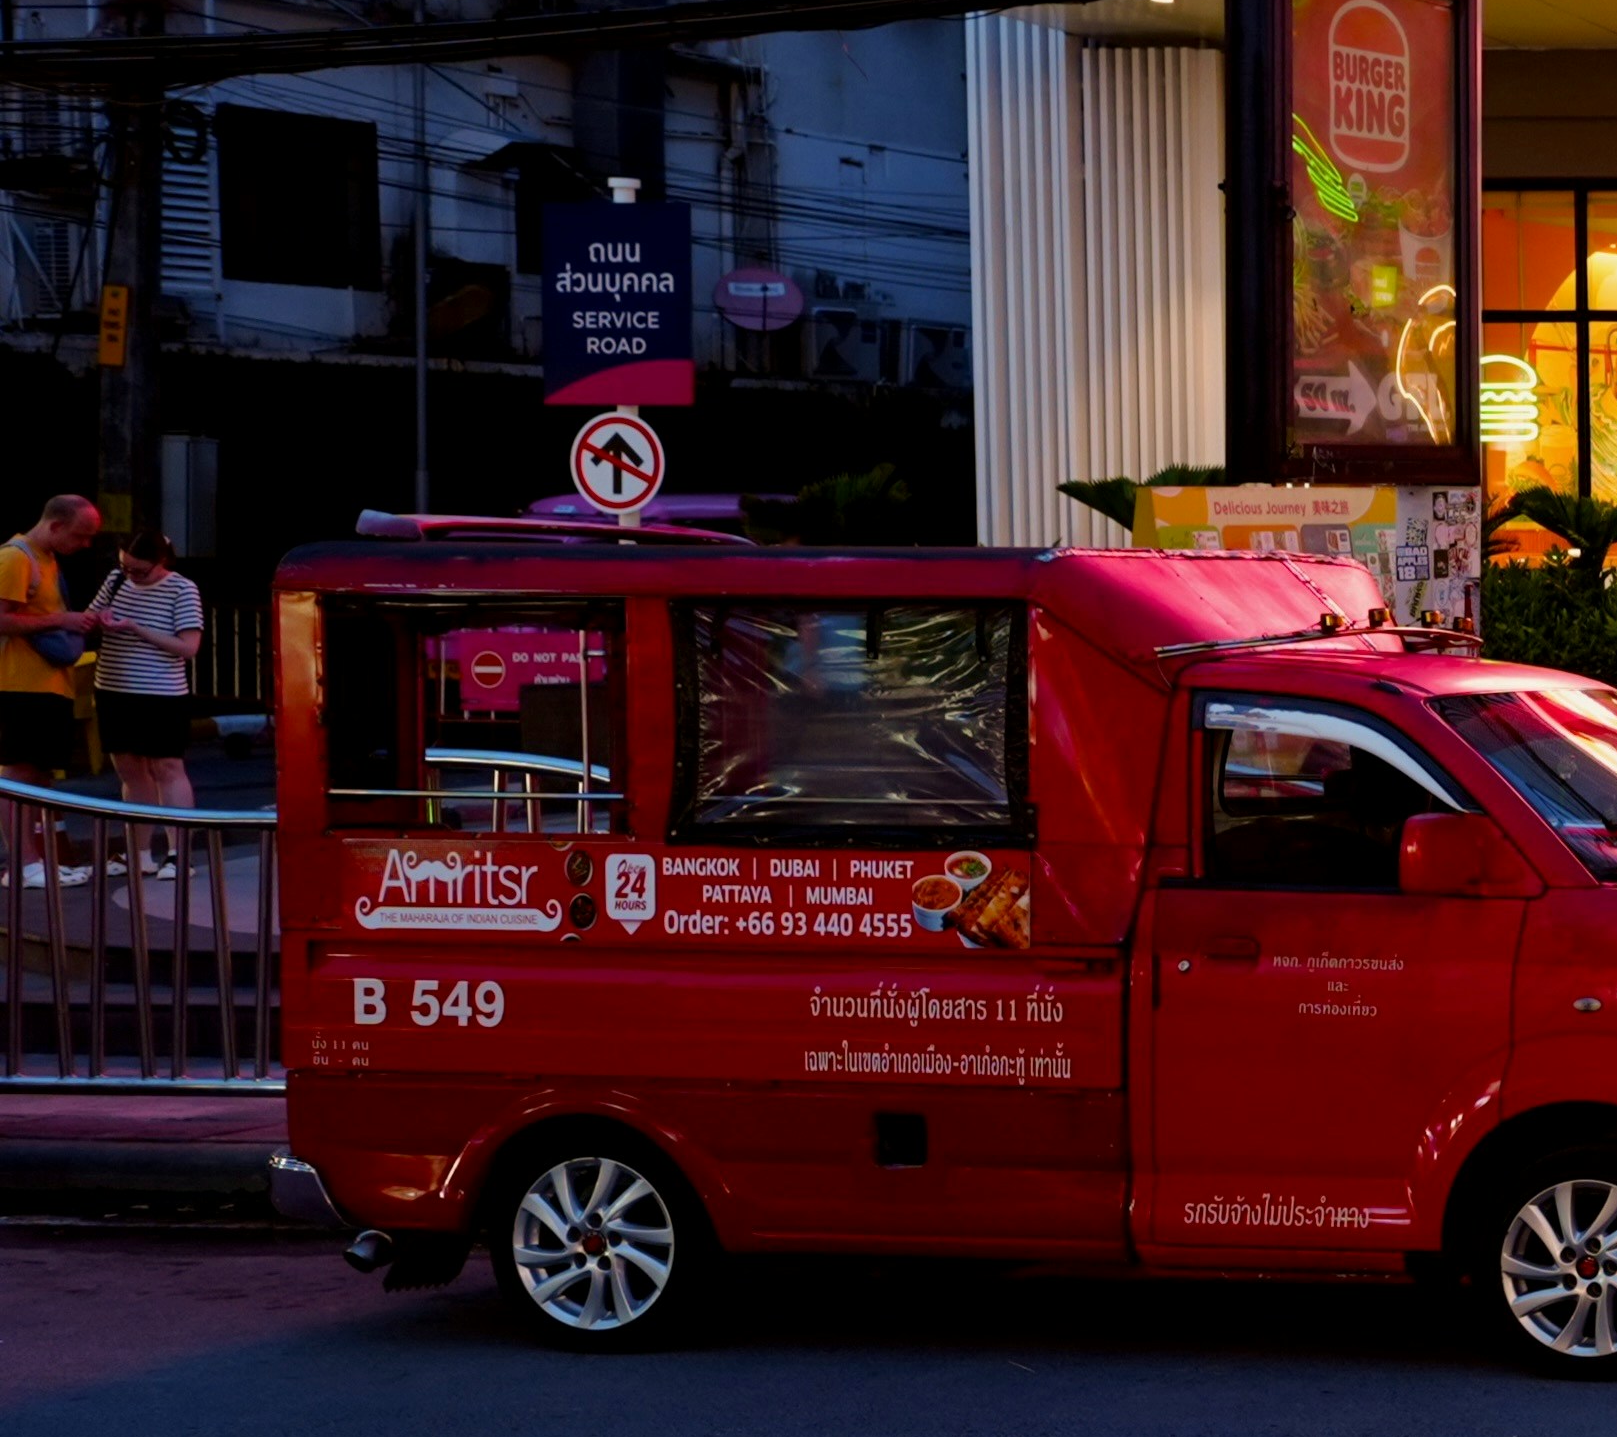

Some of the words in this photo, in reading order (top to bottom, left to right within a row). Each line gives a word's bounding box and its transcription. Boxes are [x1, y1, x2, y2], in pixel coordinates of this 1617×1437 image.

[1332, 50, 1406, 93] BURGER
[1333, 83, 1407, 138] KING
[588, 242, 641, 263] ถนน
[556, 262, 674, 302] ส่วนบุคคล
[572, 311, 660, 329] SERVICE
[586, 337, 647, 354] ROAD
[1213, 501, 1262, 516] Delicious
[1265, 501, 1306, 517] Journey
[1311, 499, 1349, 516] 美味之旅
[512, 651, 530, 663] DO
[533, 651, 558, 663] NOT
[378, 849, 539, 906] Amritsr
[662, 857, 740, 877] BANGKOK
[770, 859, 820, 878] DUBAI
[850, 860, 915, 880] PHUKET
[614, 871, 646, 899] 24
[702, 884, 772, 904] PATTAYA
[806, 886, 873, 905] MUMBAI
[615, 900, 647, 911] HOURS
[380, 911, 397, 923] THE
[400, 912, 450, 924] MAHARAJA
[452, 913, 464, 924] OF
[467, 913, 498, 924] INDIAN
[500, 914, 538, 925] CUISINE
[663, 909, 729, 935] Order:
[735, 911, 775, 935] +66
[781, 912, 808, 936] 93
[813, 912, 854, 937] 440
[859, 913, 912, 938] 4555
[1328, 980, 1350, 992] และ
[353, 978, 388, 1025] B
[410, 979, 506, 1028] 549
[995, 999, 1017, 1021] 11
[1026, 984, 1064, 1023] ที่นั่ง
[1298, 994, 1378, 1018] การท่องเที่ยว
[1183, 1192, 1370, 1229] รถรับจ้างไม่ประจำทาง
